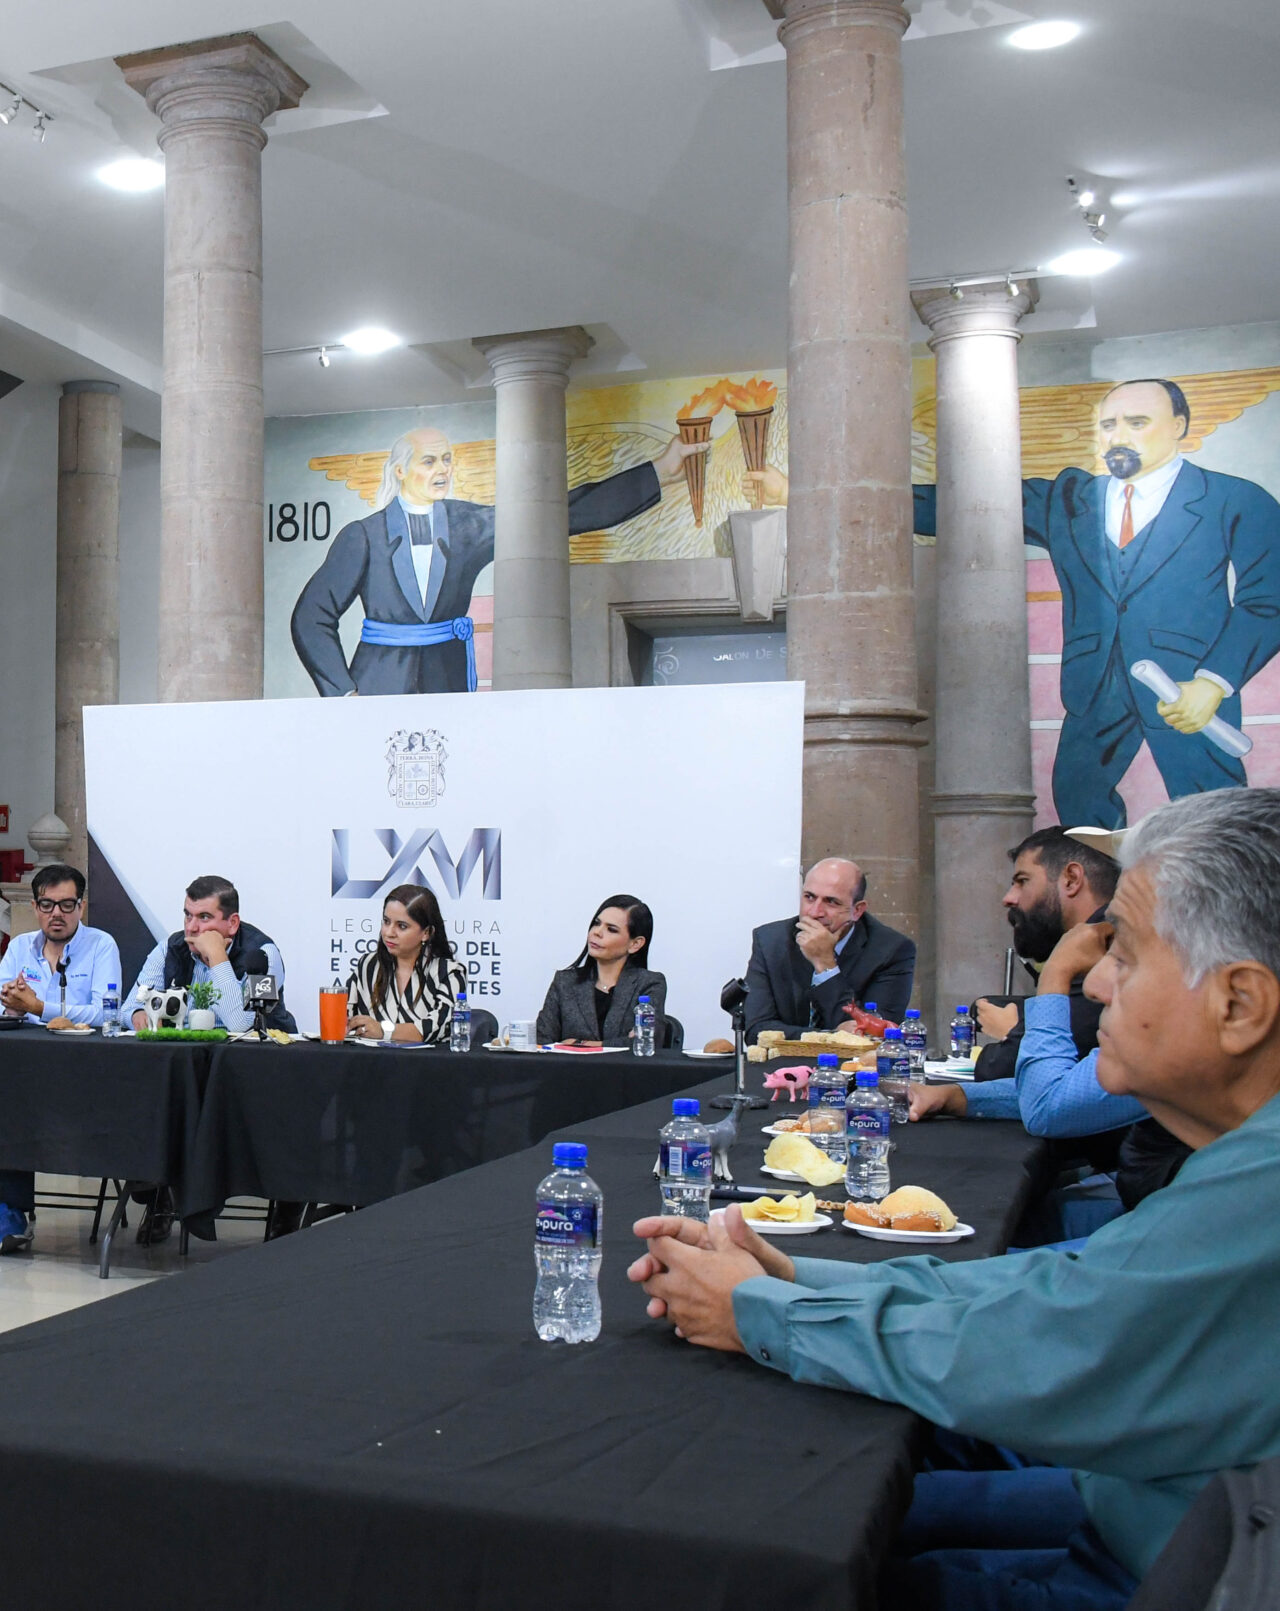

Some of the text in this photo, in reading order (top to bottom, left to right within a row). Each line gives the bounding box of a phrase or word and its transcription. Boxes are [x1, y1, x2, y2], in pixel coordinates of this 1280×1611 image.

[269, 501, 330, 542] 1810
[331, 918, 501, 934] LEGURA
[331, 939, 347, 953] H.
[466, 941, 501, 956] DEL
